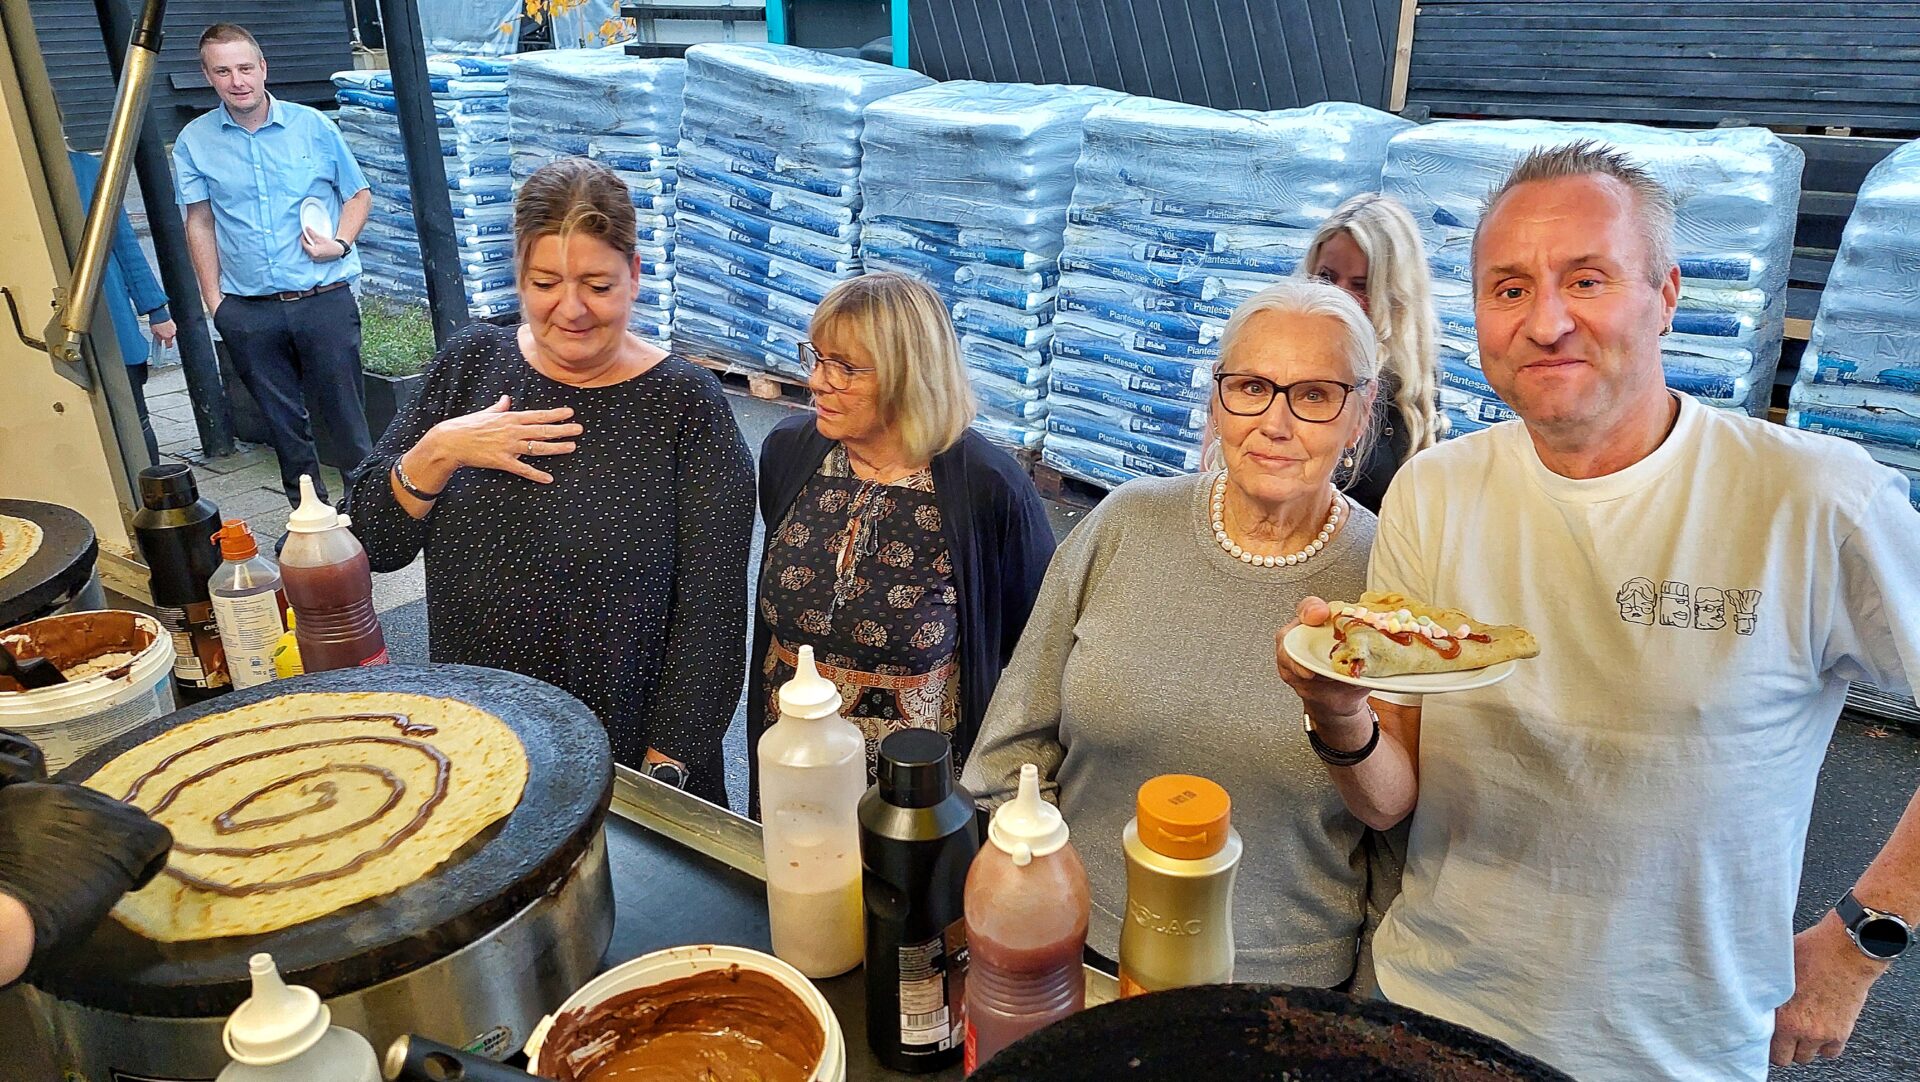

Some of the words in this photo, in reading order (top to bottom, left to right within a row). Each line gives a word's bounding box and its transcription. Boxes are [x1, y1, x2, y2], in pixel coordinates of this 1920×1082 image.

[1243, 257, 1260, 268] 40L
[1152, 277, 1167, 288] 40L
[1149, 321, 1163, 331] 40L
[1142, 365, 1156, 376] 40L
[1141, 404, 1154, 415] 40L
[1136, 444, 1150, 454] 40L
